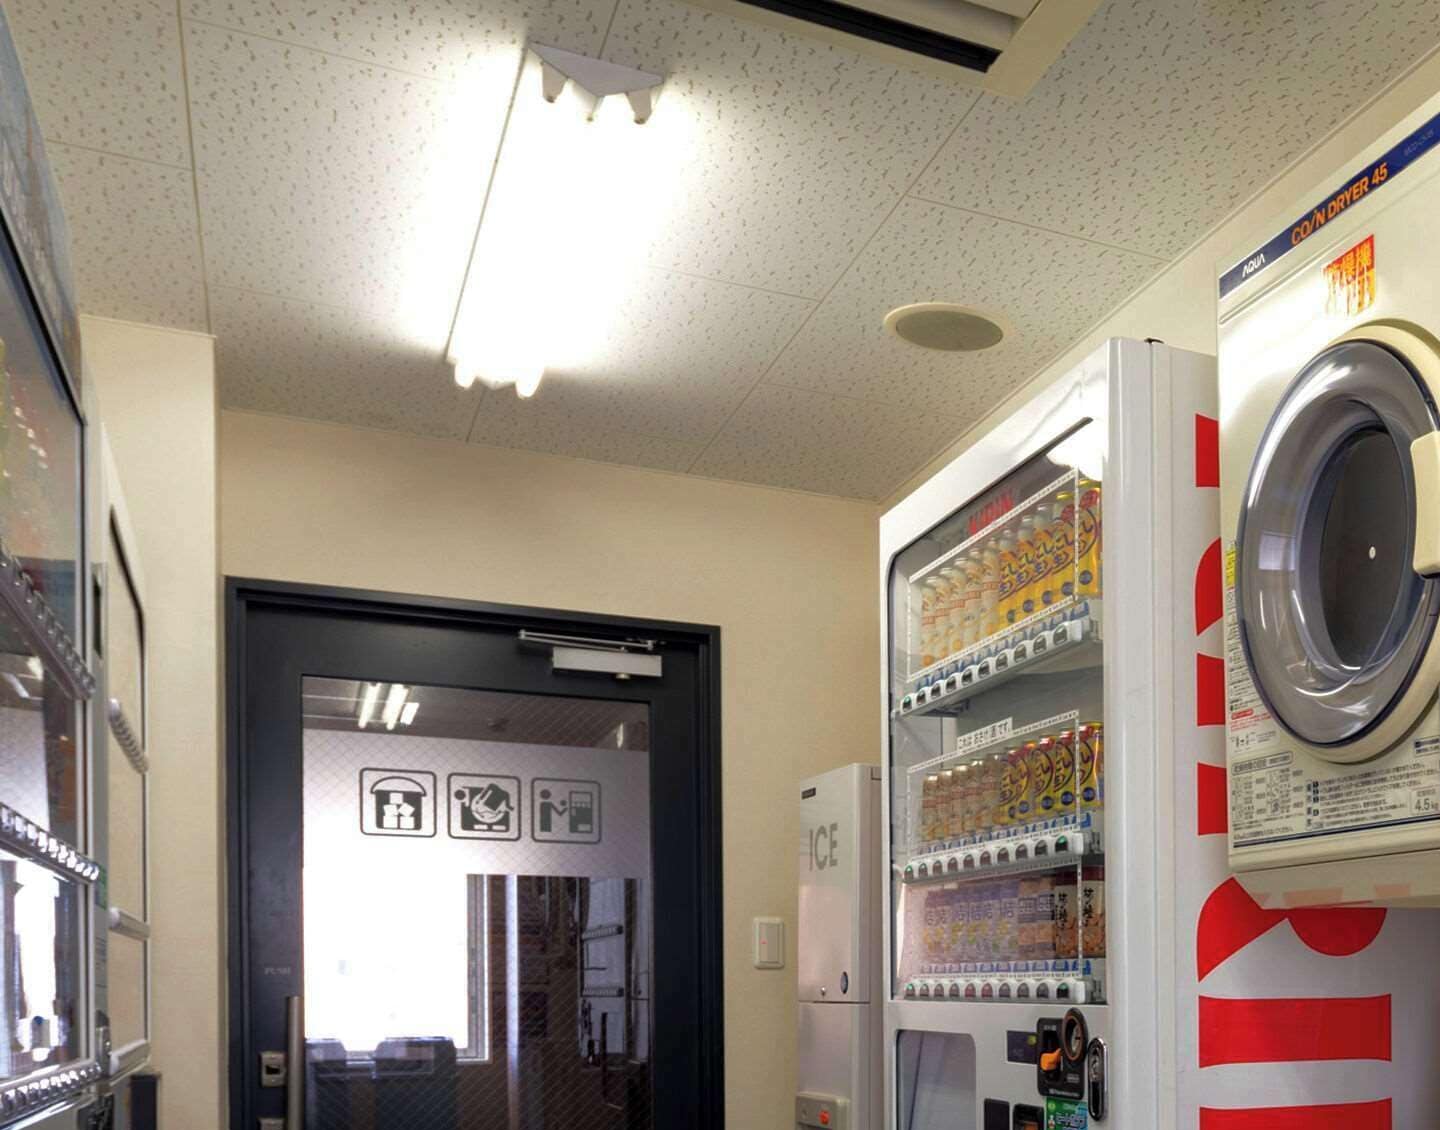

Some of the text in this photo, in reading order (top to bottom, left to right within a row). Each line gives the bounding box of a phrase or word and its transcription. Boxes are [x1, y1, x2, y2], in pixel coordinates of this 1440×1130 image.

[1327, 176, 1369, 220] DRYER
[1372, 163, 1388, 185] 45
[1242, 253, 1265, 278] AQUA
[809, 822, 838, 871] ICE
